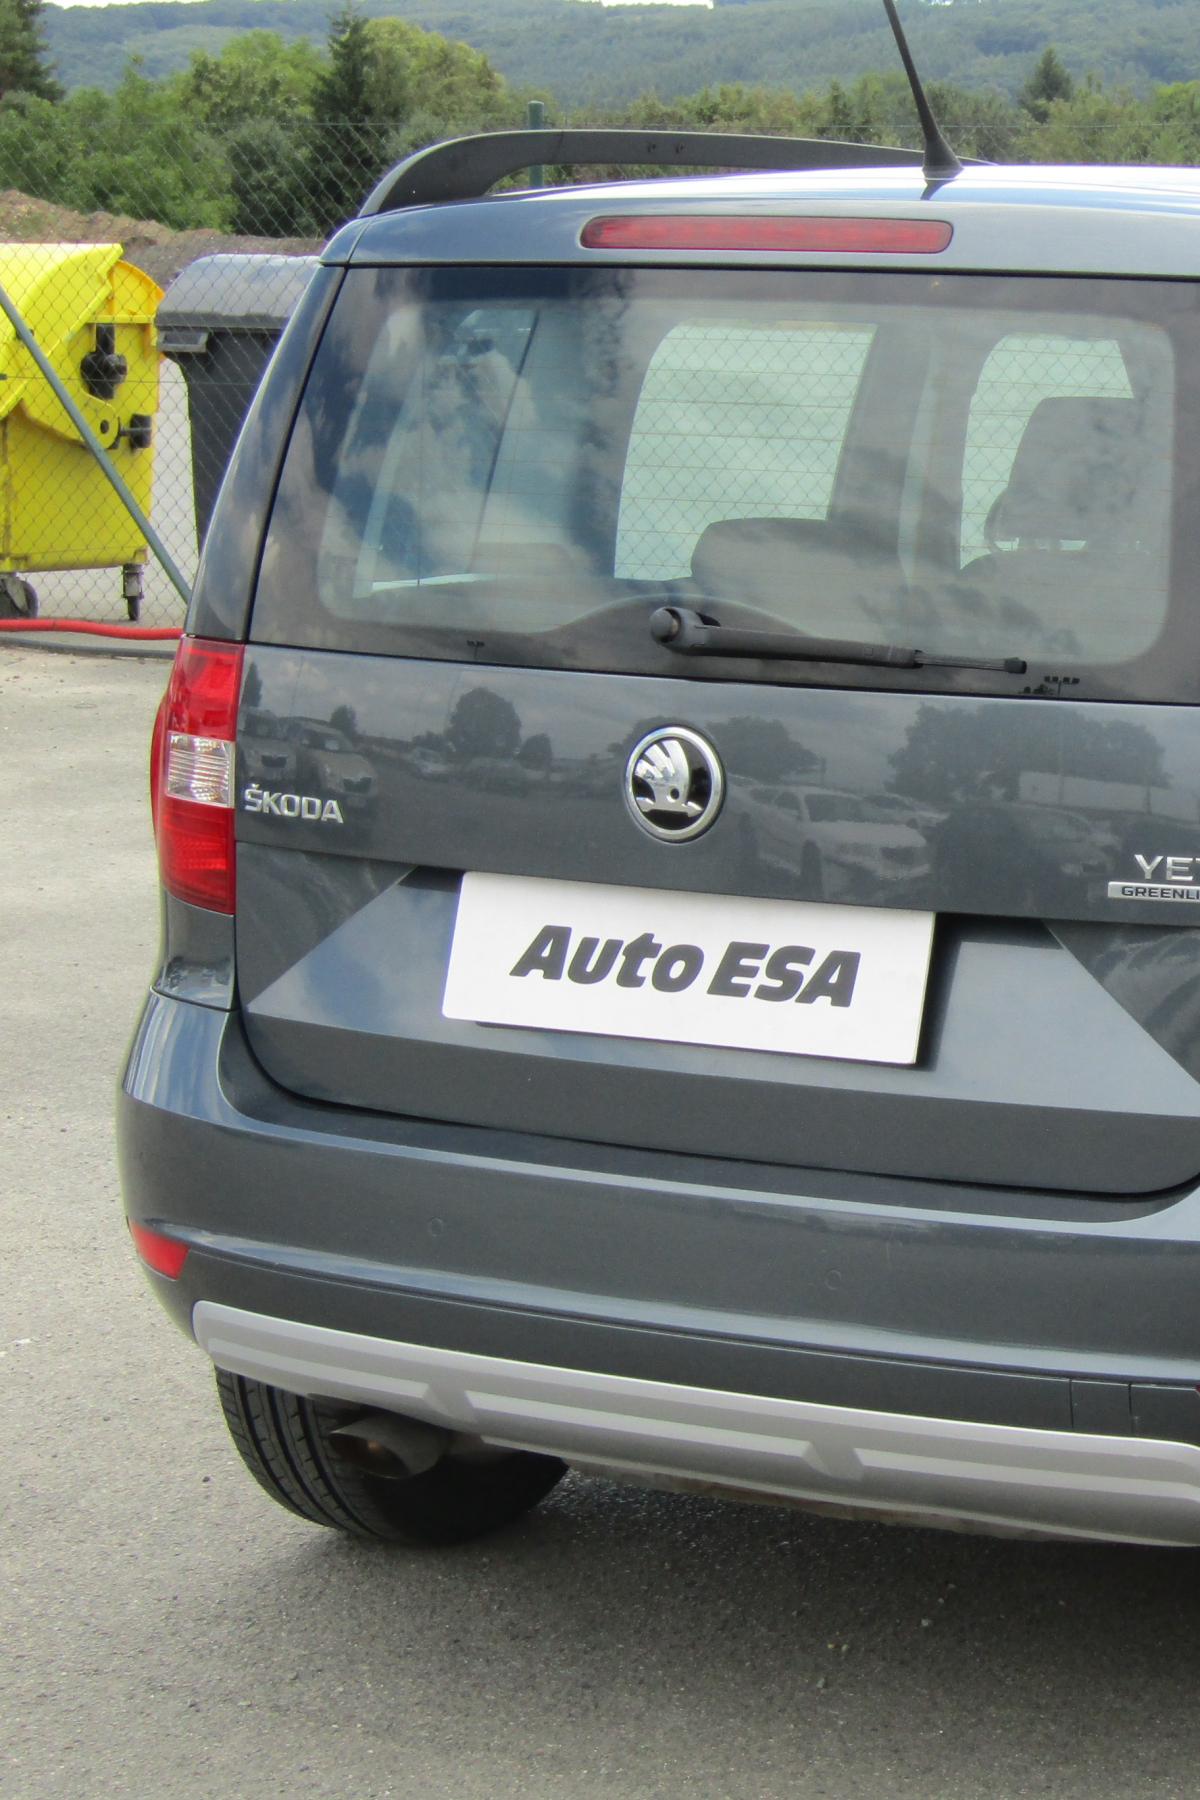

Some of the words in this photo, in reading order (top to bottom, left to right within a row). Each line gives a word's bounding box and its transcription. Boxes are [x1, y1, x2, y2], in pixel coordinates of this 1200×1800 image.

[244, 783, 344, 824] ŠKODA
[508, 924, 705, 993] Auto
[706, 941, 861, 1008] ESA
